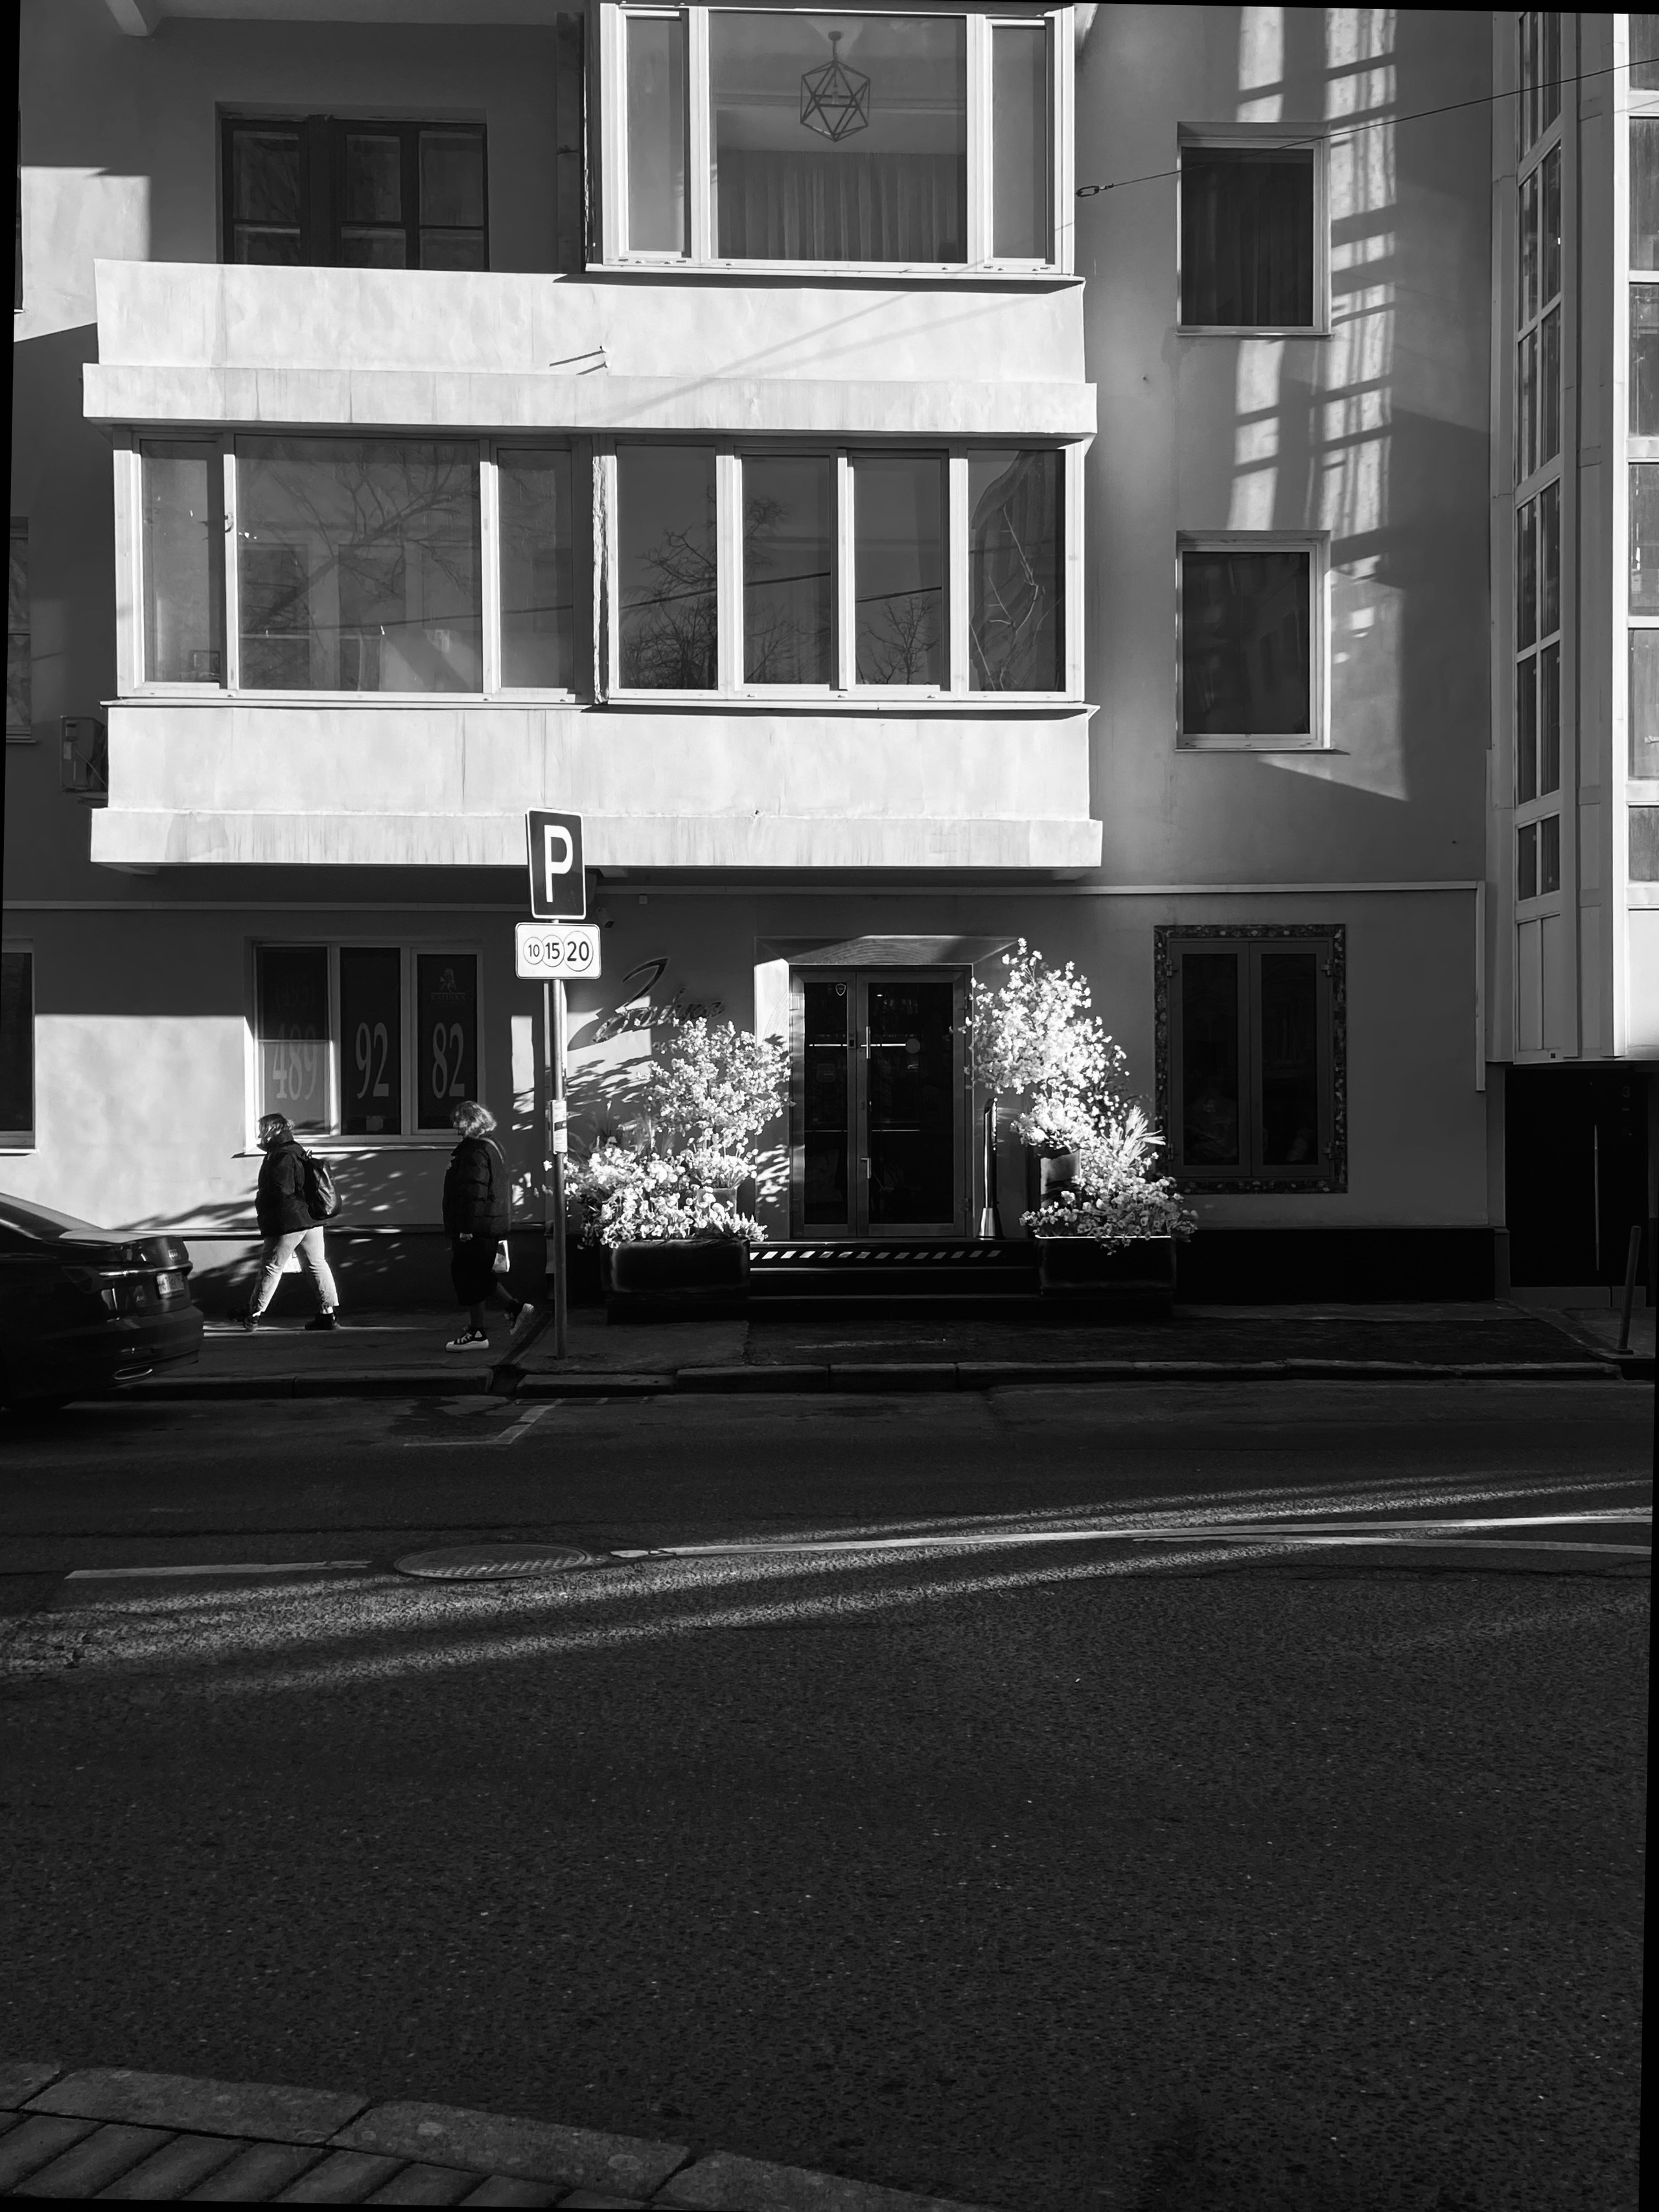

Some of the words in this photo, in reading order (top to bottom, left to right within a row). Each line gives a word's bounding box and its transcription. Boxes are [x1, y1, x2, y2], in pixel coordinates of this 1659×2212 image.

[544, 824, 574, 903] P
[528, 944, 540, 956] 10
[545, 942, 561, 959] 15
[567, 941, 590, 961] 20
[272, 1022, 318, 1101] 489
[355, 1022, 389, 1099] 92
[432, 1022, 465, 1099] 82
